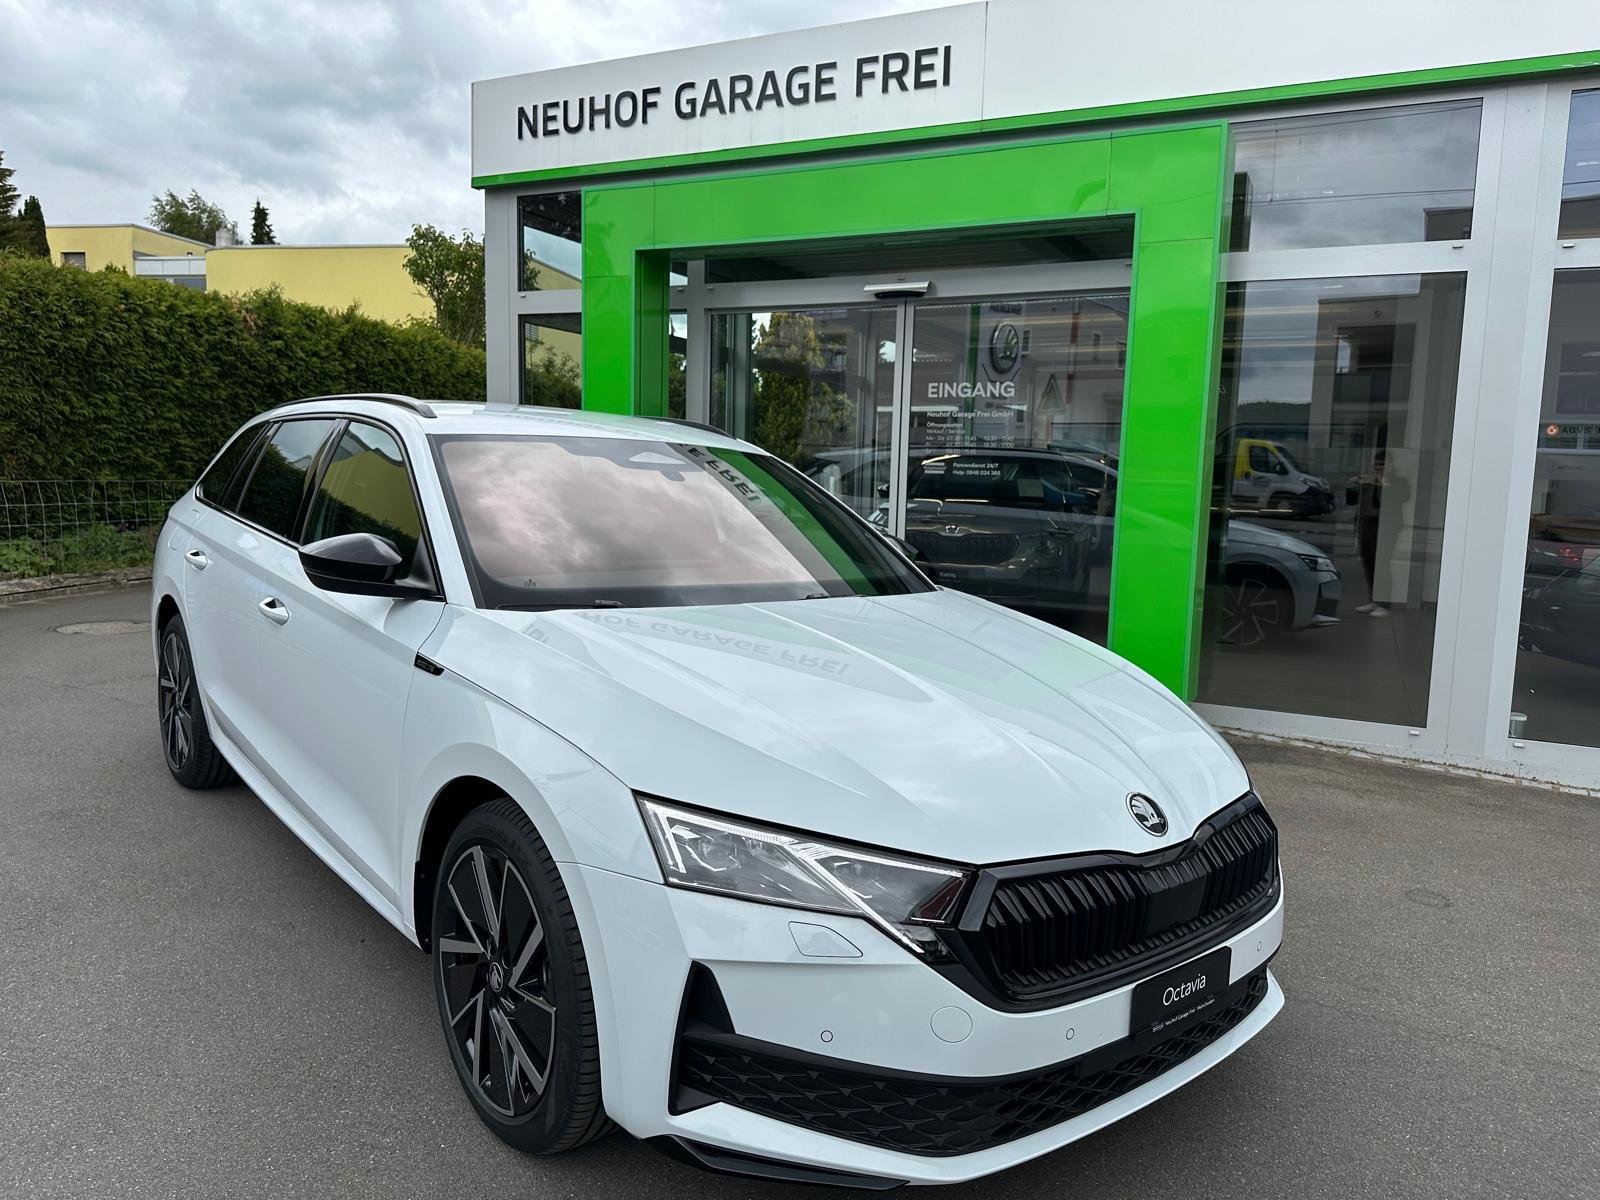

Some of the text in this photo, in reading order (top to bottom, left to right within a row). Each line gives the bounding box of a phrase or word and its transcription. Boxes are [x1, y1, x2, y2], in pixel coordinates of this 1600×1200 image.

[517, 45, 952, 141] NEUHOF GARAGE FREI
[927, 381, 1016, 399] EINGANG
[951, 411, 977, 419] Garage
[1163, 973, 1206, 1006] Octavia
